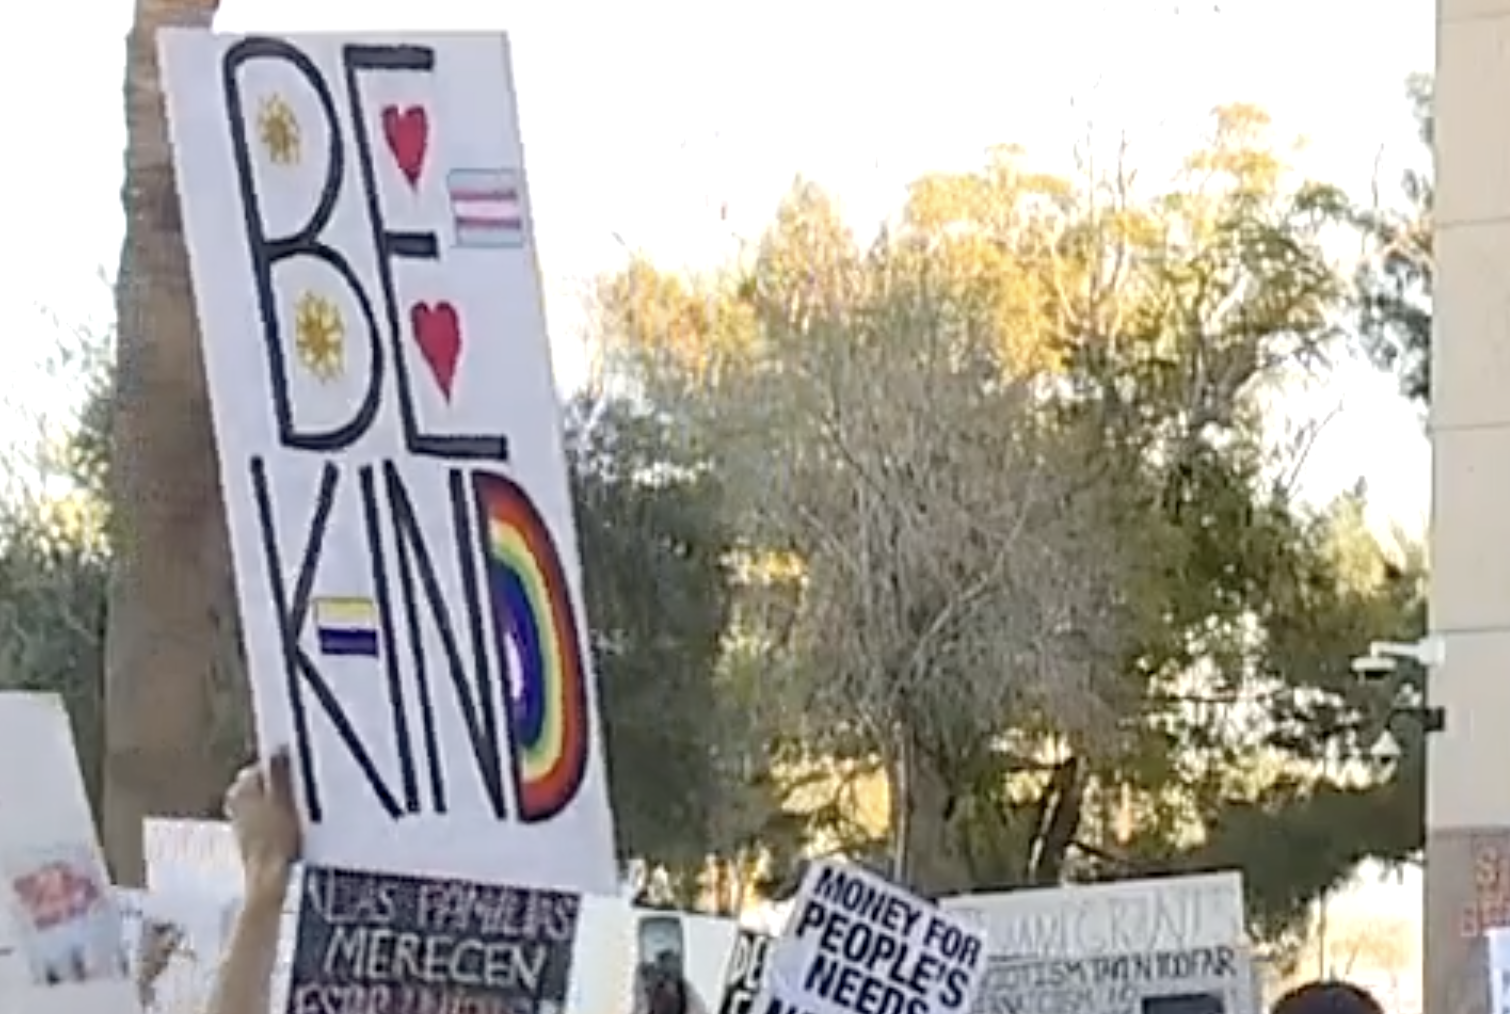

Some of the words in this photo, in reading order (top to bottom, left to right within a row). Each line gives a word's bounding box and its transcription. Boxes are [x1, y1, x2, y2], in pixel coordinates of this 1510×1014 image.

[222, 36, 508, 461] BE
[251, 457, 588, 823] KIND
[322, 925, 546, 989] MERECEN
[796, 900, 969, 1009] PEOPLE'S
[814, 865, 922, 937] MONEY
[923, 915, 982, 969] FOR
